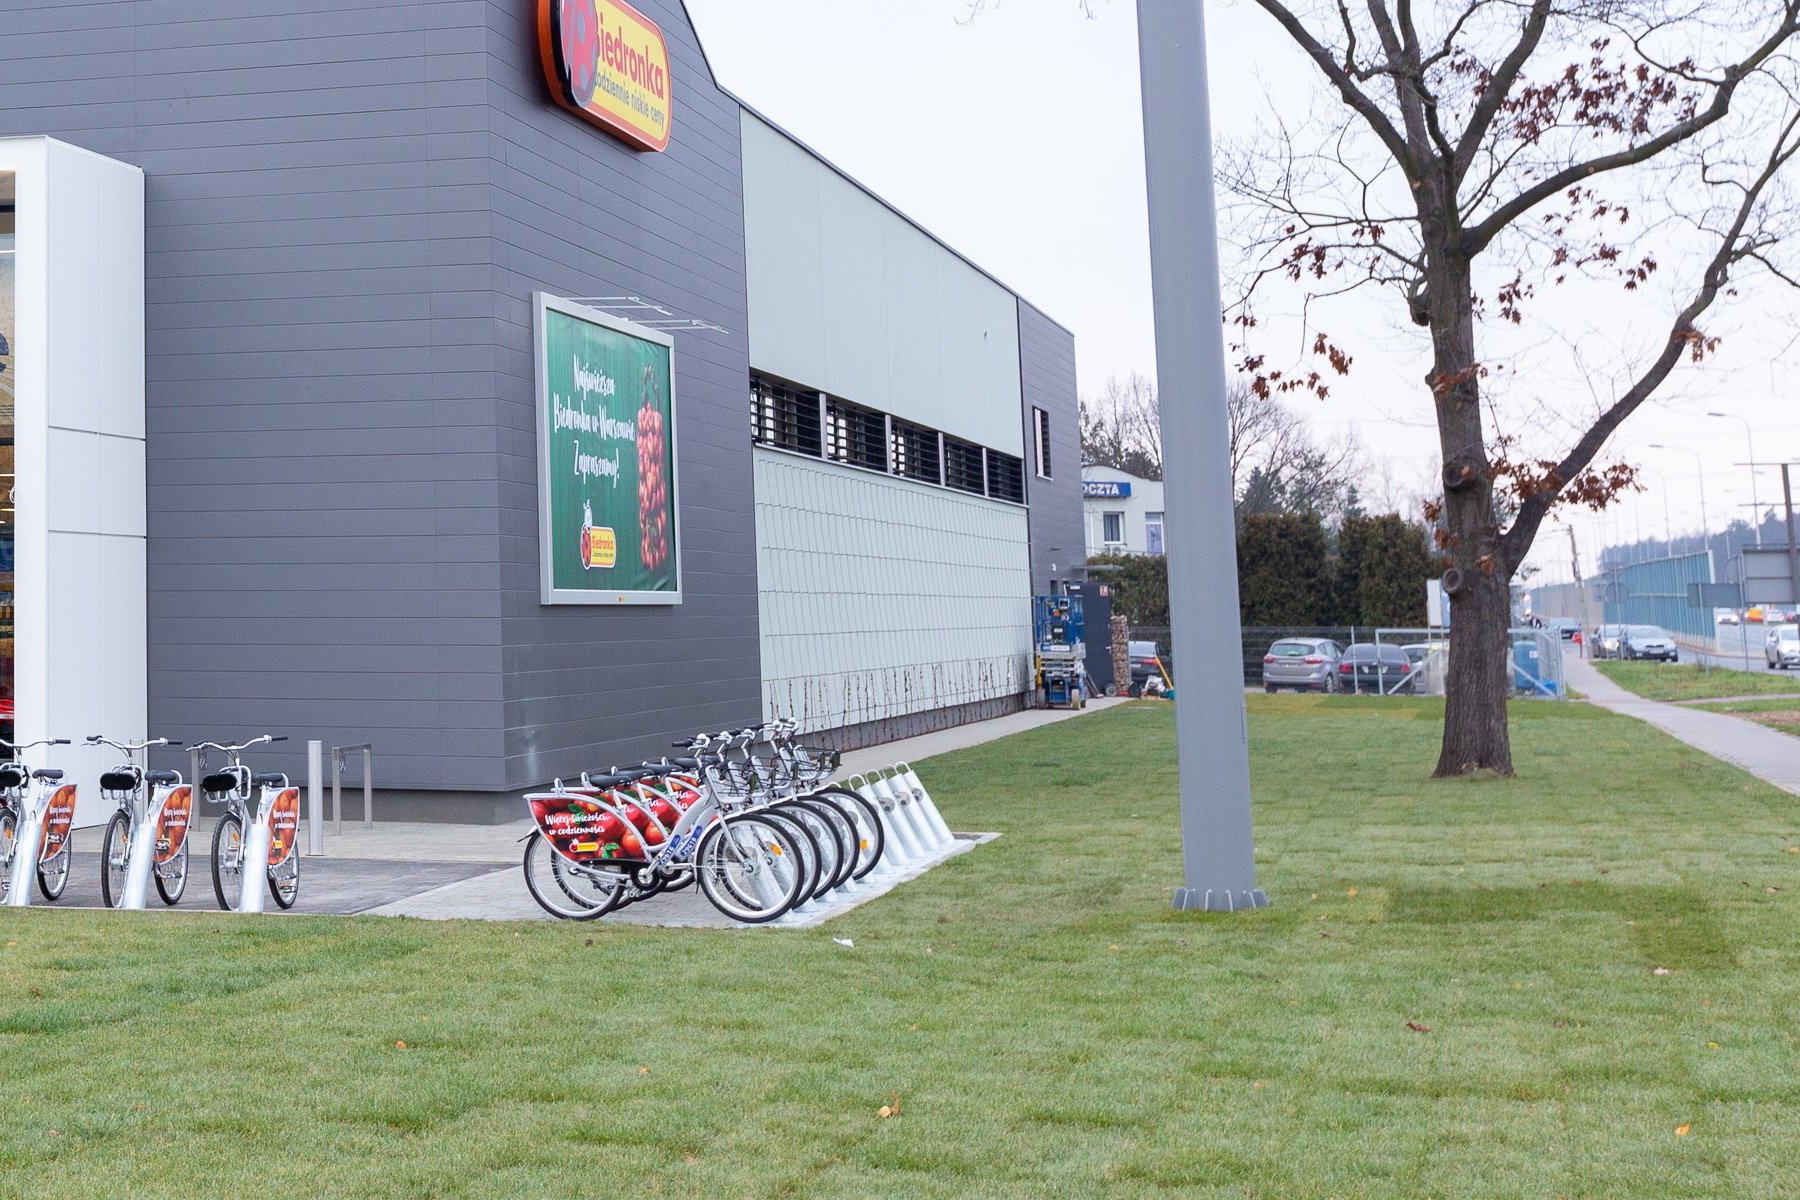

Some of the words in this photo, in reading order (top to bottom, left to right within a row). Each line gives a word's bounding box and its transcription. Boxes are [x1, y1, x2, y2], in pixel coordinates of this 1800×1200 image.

[597, 11, 664, 100] iedronka
[595, 68, 630, 106] odziennie
[631, 89, 649, 118] niskie
[650, 106, 665, 131] ceny
[553, 392, 591, 433] Biedronka
[544, 814, 570, 826] Więcej
